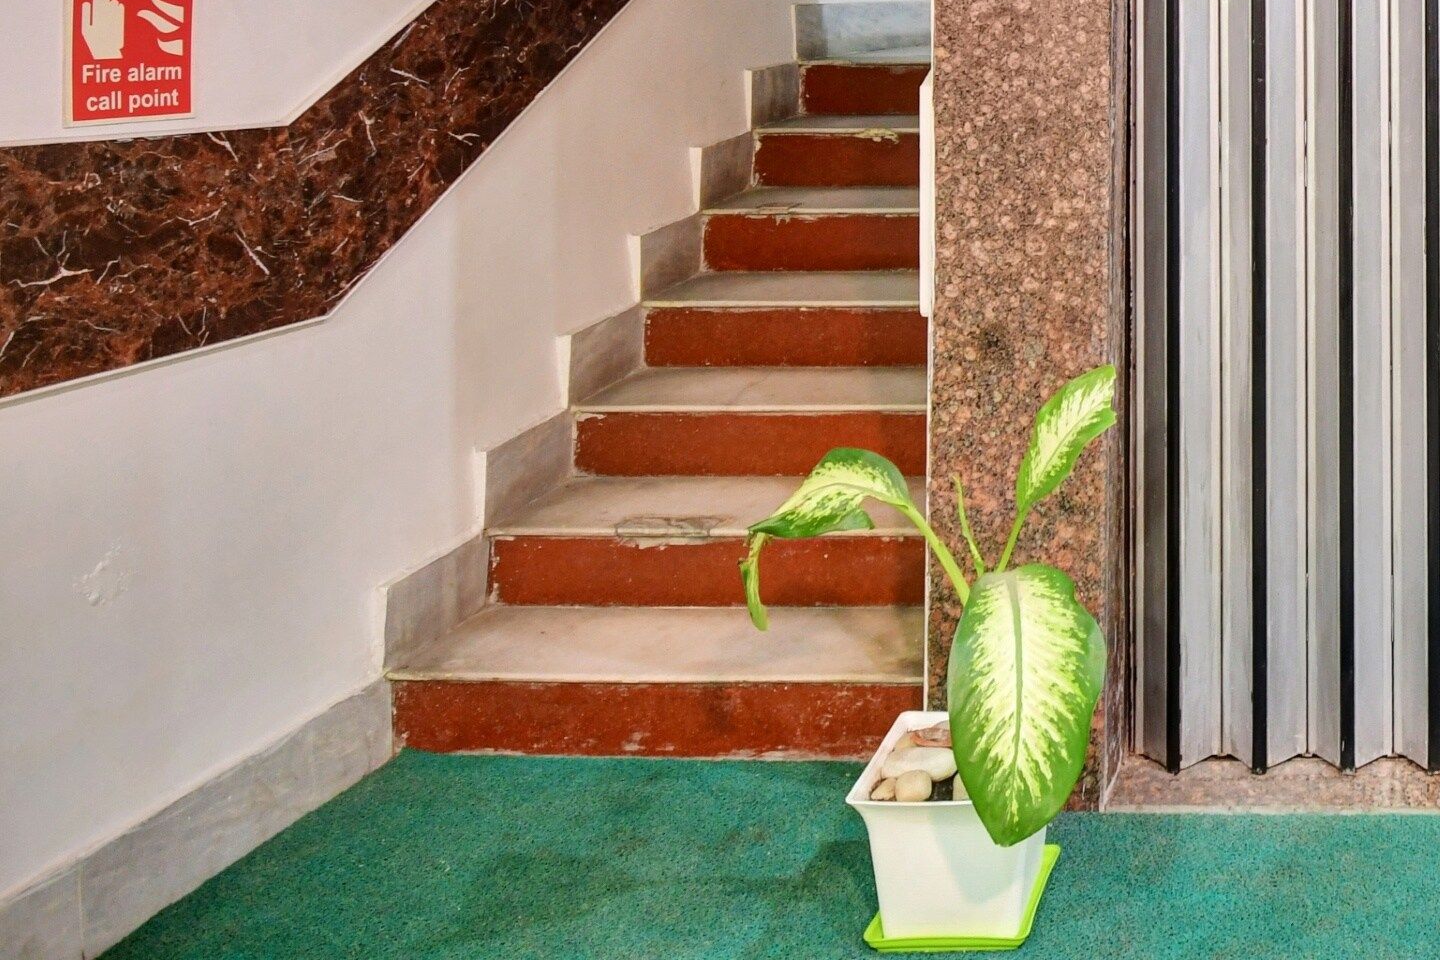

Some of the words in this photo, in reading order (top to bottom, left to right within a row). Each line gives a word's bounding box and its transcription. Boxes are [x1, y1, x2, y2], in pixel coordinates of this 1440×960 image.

[82, 64, 122, 84] Fire
[127, 62, 182, 82] alarm
[86, 90, 122, 112] call
[128, 88, 179, 114] point
